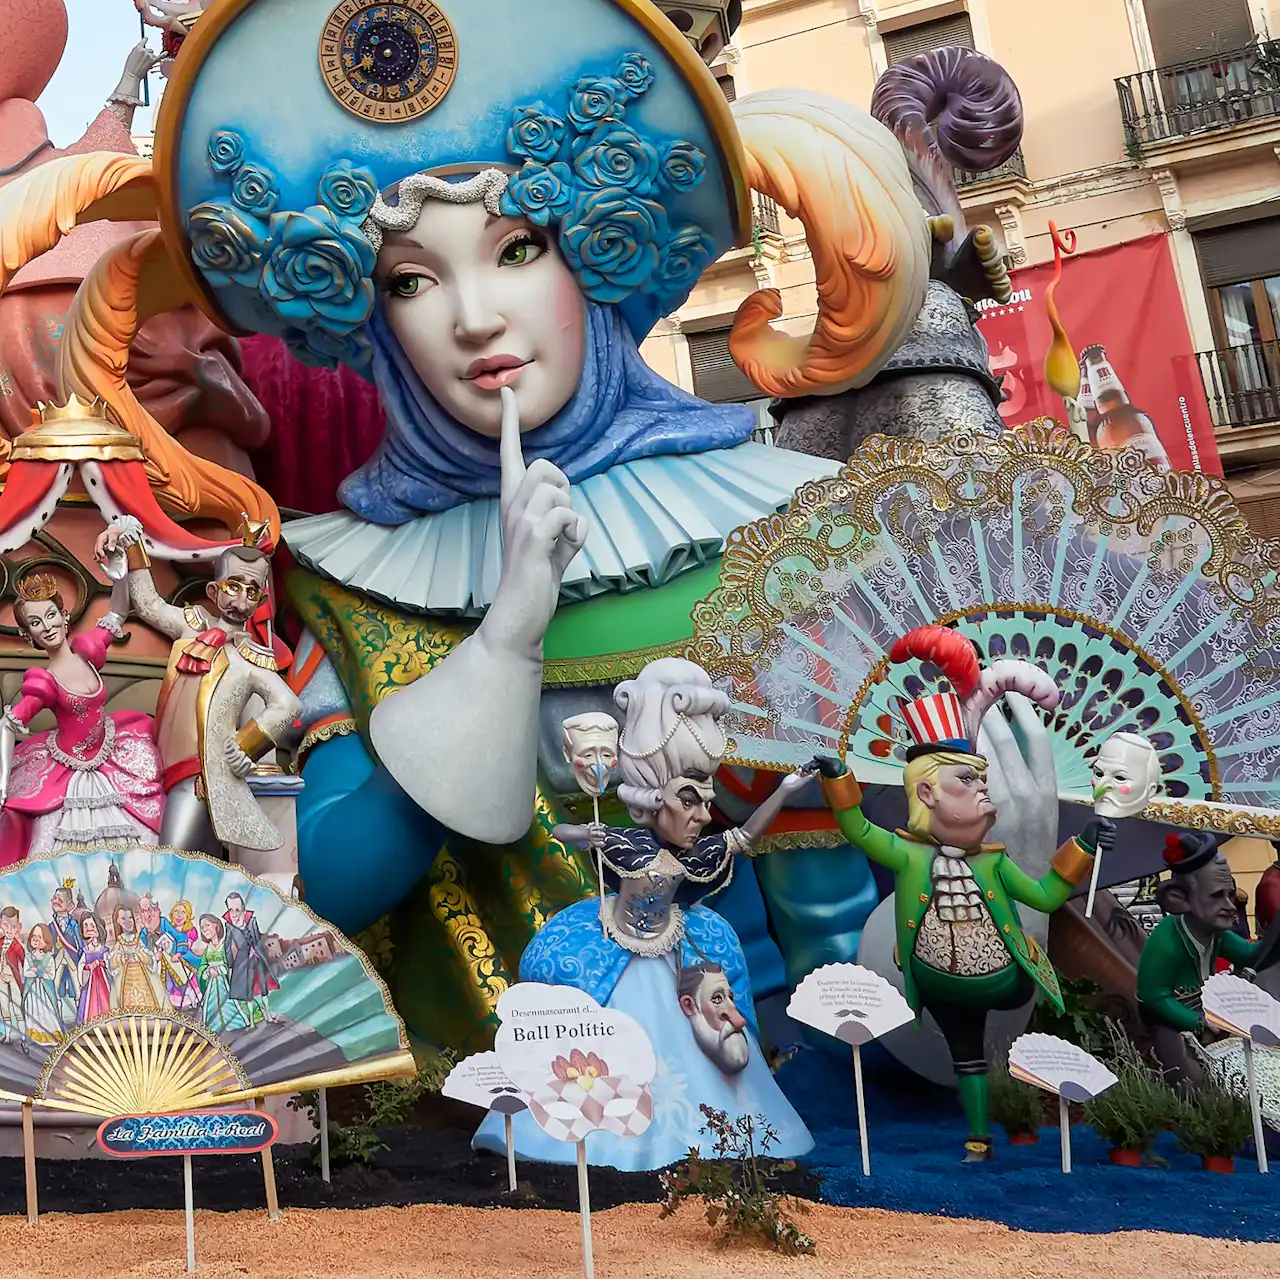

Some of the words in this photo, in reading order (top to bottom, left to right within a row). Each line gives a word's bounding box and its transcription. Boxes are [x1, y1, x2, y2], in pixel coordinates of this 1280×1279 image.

[511, 1006, 580, 1018] Desenmascarant
[512, 1025, 550, 1042] Ball
[554, 1022, 615, 1040] Polític
[106, 1125, 133, 1141] La
[136, 1124, 206, 1142] Familia
